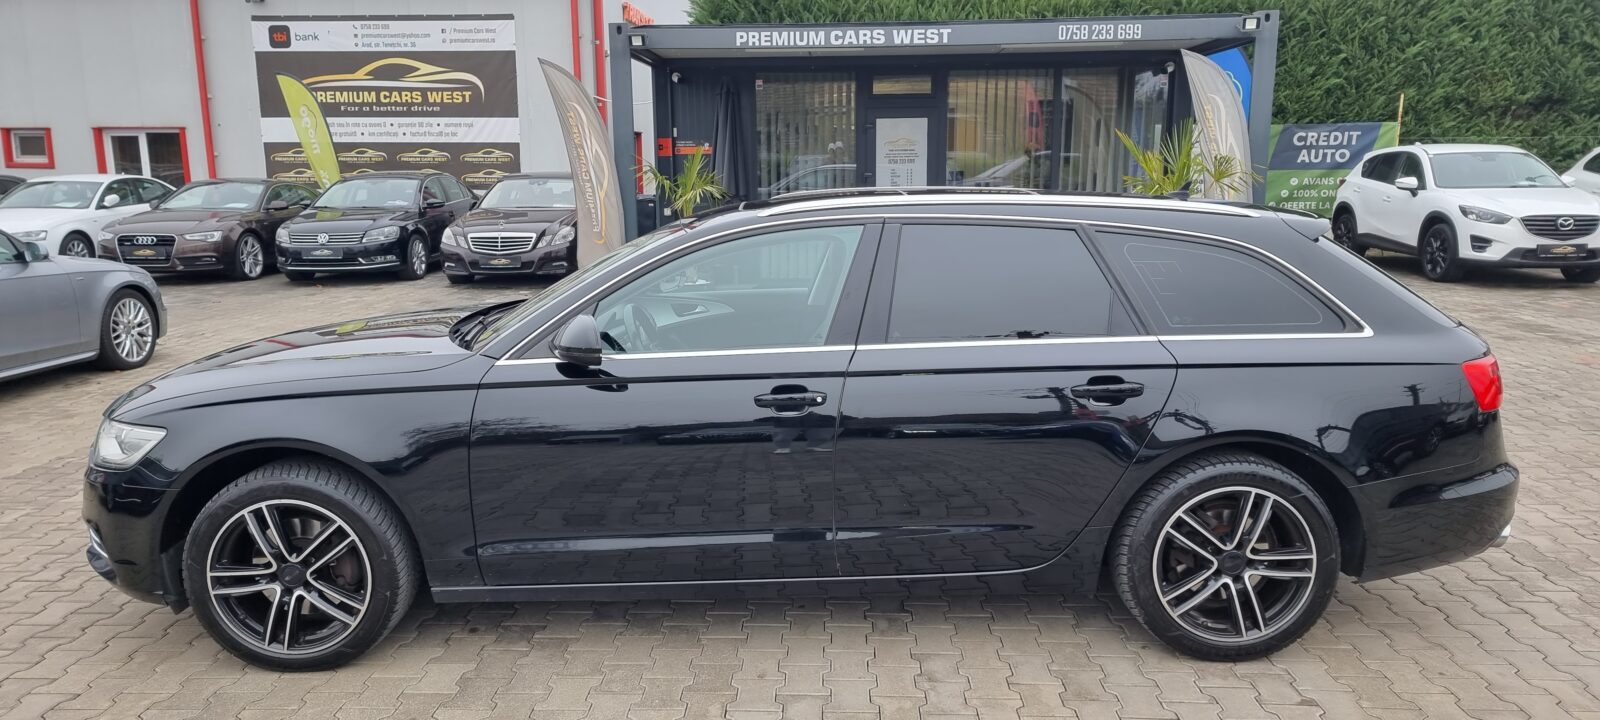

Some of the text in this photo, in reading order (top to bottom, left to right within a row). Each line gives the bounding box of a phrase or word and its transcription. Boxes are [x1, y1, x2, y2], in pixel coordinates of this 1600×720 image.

[272, 31, 288, 42] tbi
[294, 32, 320, 42] bank
[735, 29, 951, 46] PREMIUM CARS WEST
[1058, 23, 1142, 41] 0758 233 699
[379, 91, 422, 103] CARS
[427, 91, 472, 103] WEST
[1292, 131, 1361, 146] CREDIT
[1297, 148, 1350, 163] AUTO
[1302, 177, 1335, 185] AVANS
[1292, 189, 1319, 198] 100%
[1280, 201, 1331, 210] OFERTE LA
